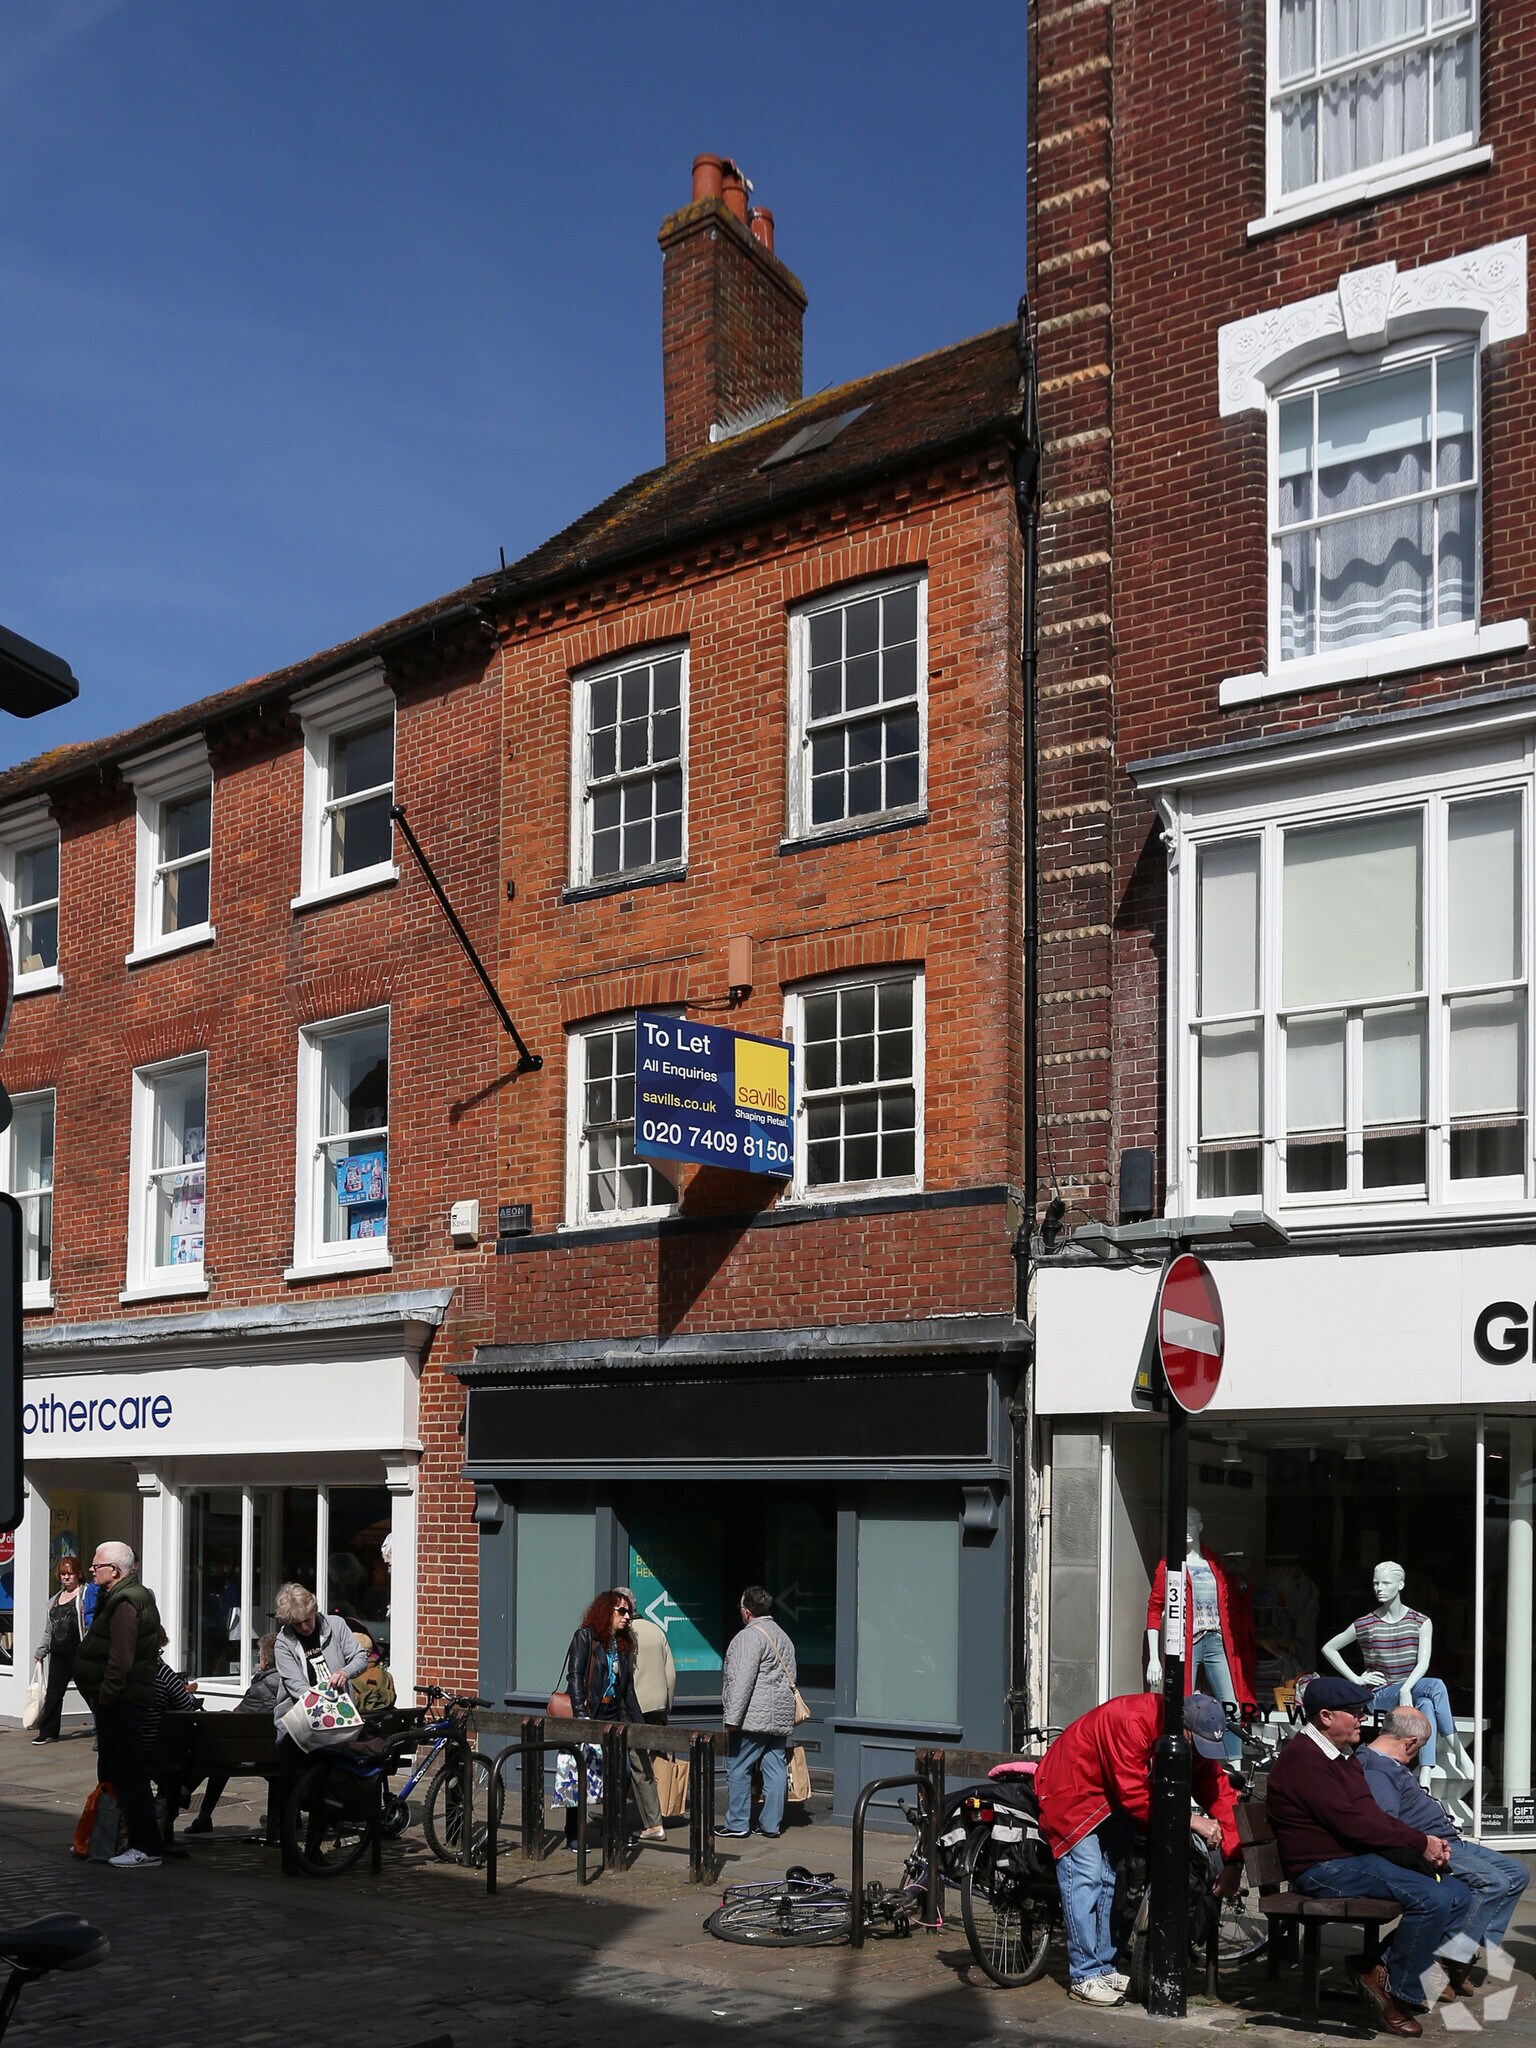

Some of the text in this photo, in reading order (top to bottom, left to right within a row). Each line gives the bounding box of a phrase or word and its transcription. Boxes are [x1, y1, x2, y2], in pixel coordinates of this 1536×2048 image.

[643, 1022, 711, 1055] To Let
[643, 1059, 718, 1083] All Enquiries
[643, 1092, 717, 1113] savills.co.uk
[738, 1086, 786, 1111] savills
[735, 1108, 765, 1125] Shaping
[643, 1120, 788, 1163] 020 7409 8150
[500, 1207, 524, 1217] AEON
[23, 1393, 172, 1434] othercare
[1169, 1588, 1179, 1602] 3
[1169, 1605, 1179, 1619] E
[1513, 1806, 1535, 1816] GIFT
